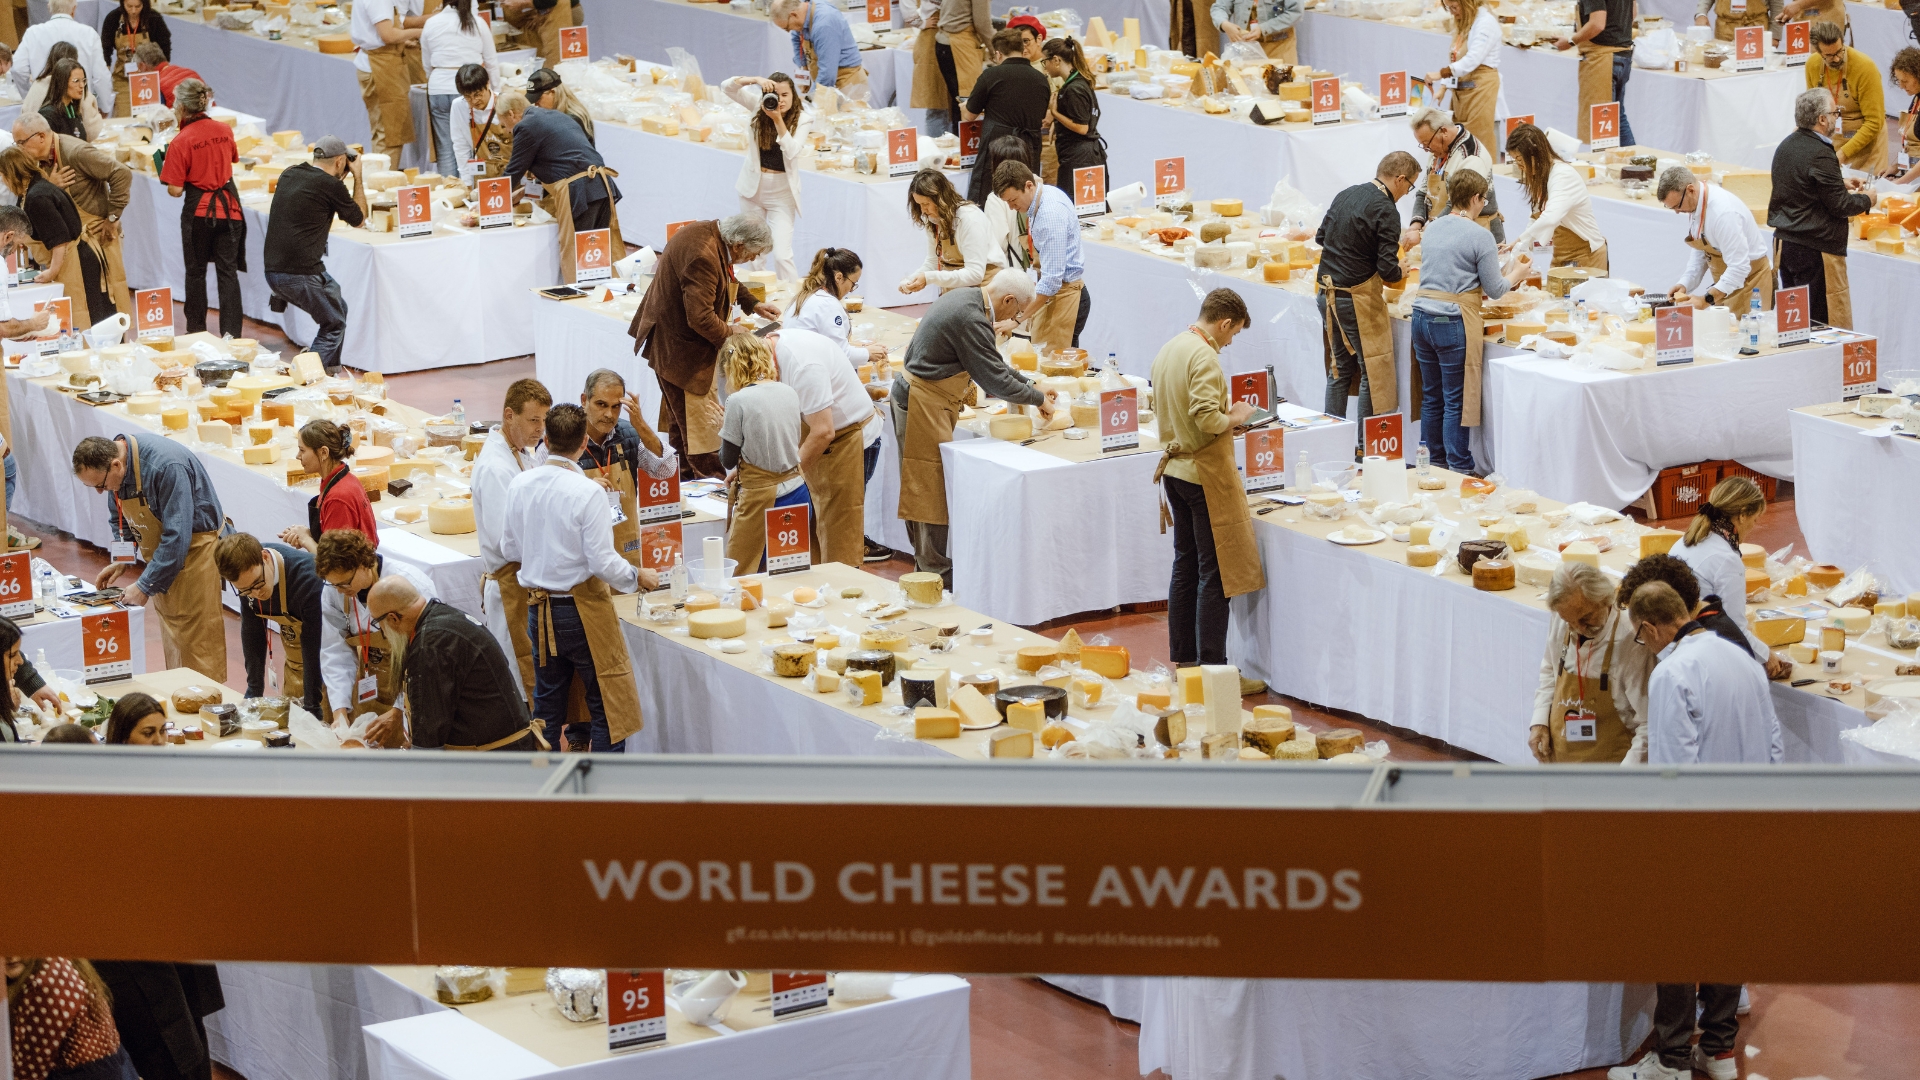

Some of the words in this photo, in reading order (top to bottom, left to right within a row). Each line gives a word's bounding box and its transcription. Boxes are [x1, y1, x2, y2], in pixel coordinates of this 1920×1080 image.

[872, 6, 885, 18] 43
[567, 41, 582, 54] 42
[1742, 42, 1757, 55] 45
[1791, 37, 1804, 49] 46
[138, 88, 153, 100] 40
[1319, 94, 1334, 107] 43
[1386, 87, 1401, 99] 44
[1598, 120, 1612, 133] 74
[192, 140, 209, 151] WCA
[211, 136, 229, 145] TEAM
[967, 136, 980, 150] 42
[895, 144, 909, 158] 41
[1163, 174, 1178, 188] 72
[1082, 185, 1096, 199] 71
[487, 195, 504, 209] 40
[407, 203, 423, 218] 39
[584, 248, 601, 263] 69
[146, 307, 164, 323] 68
[1785, 308, 1801, 324] 72
[1665, 326, 1682, 342] 71
[1848, 359, 1871, 377] 101
[1241, 393, 1259, 406] 70
[1110, 410, 1129, 427] 69
[1371, 436, 1398, 455] 100
[1255, 450, 1274, 468] 99
[650, 480, 669, 498] 68
[778, 529, 799, 548] 98
[652, 546, 672, 564] 97
[0, 577, 21, 596] 66
[95, 636, 119, 656] 96
[583, 859, 815, 902] WORLD
[837, 862, 1067, 906] CHEESE
[1087, 865, 1363, 911] AWARDS
[726, 926, 895, 944] gff.co.uk/worldcheese
[910, 927, 1043, 946] @guildoffinefood
[1053, 929, 1221, 948] #worldcheeseawards
[622, 987, 650, 1012] 95
